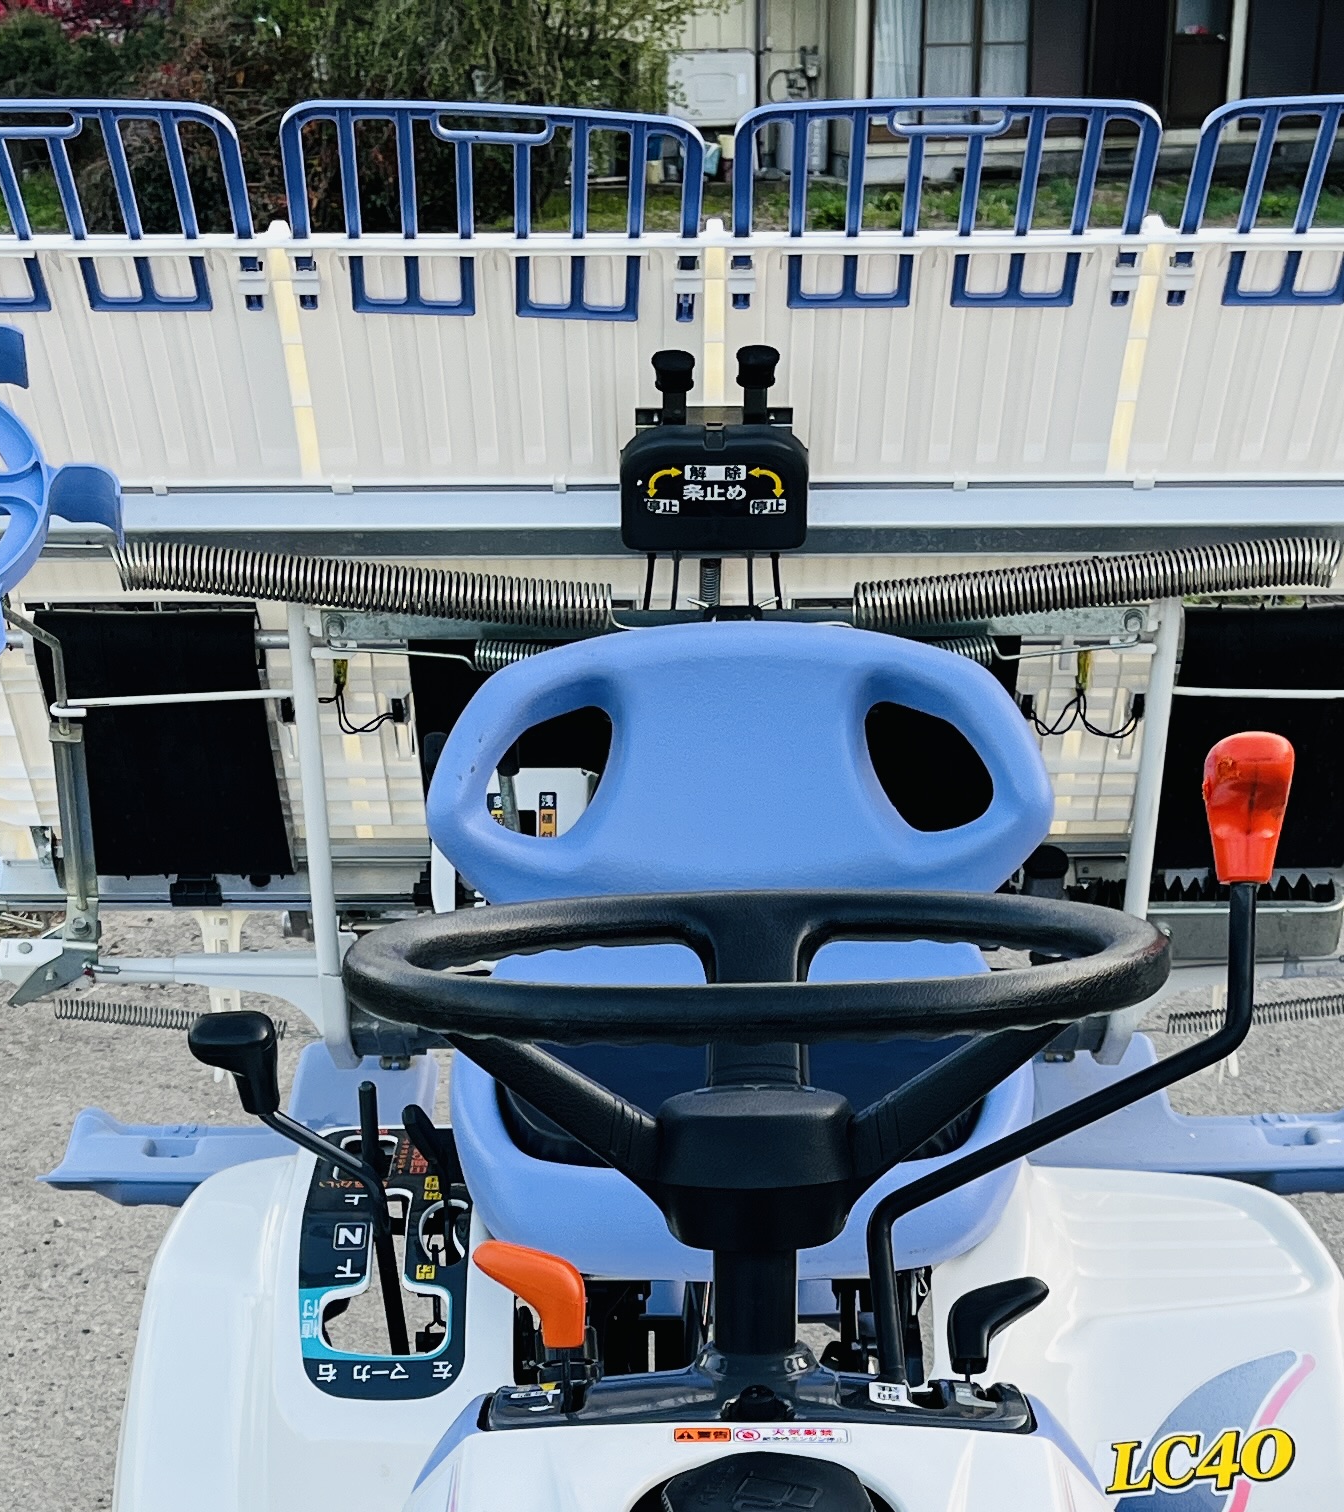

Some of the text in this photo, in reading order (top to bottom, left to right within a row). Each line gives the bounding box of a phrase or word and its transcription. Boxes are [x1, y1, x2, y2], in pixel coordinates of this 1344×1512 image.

[682, 483, 747, 501] 条止め
[337, 1227, 363, 1245] N
[334, 1257, 361, 1278] 下
[316, 1363, 338, 1383] 右
[432, 1360, 453, 1380] 左
[1105, 1427, 1296, 1495] LC40
